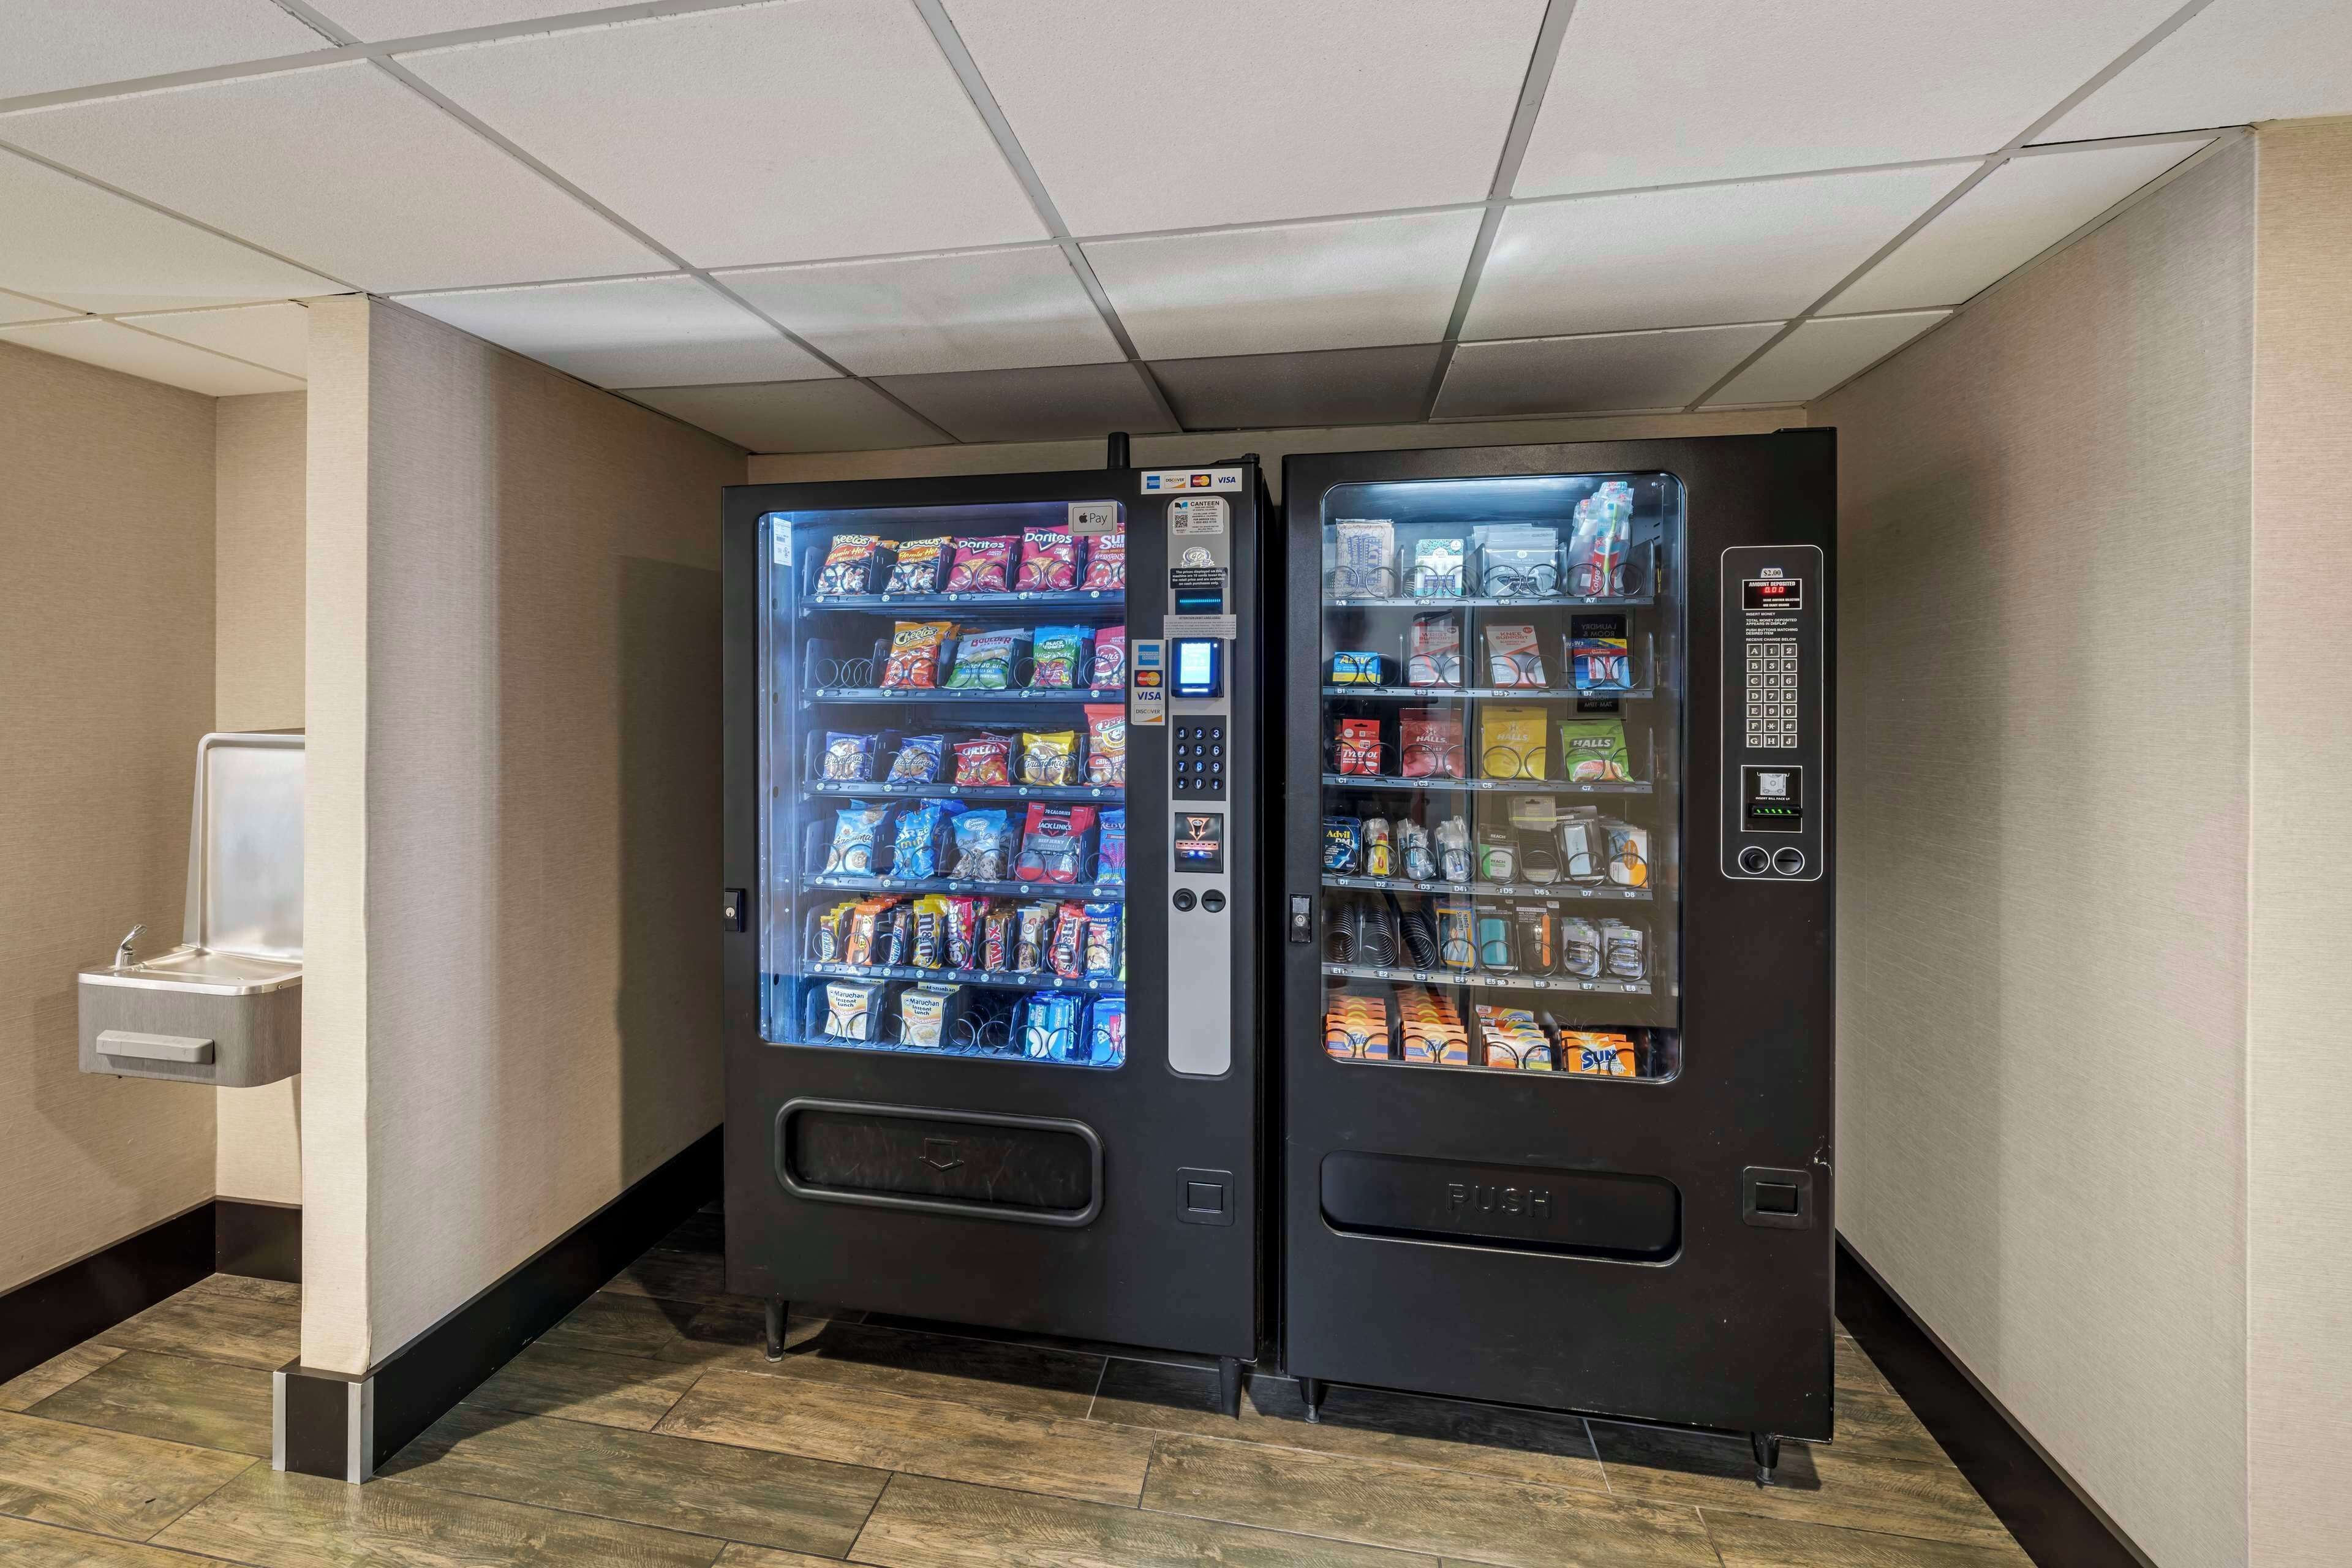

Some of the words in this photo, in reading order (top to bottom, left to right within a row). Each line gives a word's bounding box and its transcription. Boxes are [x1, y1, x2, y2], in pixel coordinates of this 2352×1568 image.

[1090, 513, 1107, 524] Pay
[1025, 533, 1071, 543] Doritos
[899, 551, 925, 561] Flamin'
[895, 627, 939, 646] Cheetos
[971, 638, 1011, 647] BOULDER
[1196, 746, 1202, 755] 5
[825, 755, 864, 764] Grandma's
[1025, 760, 1065, 769] Grandma's
[1196, 763, 1202, 771] 8
[1196, 780, 1201, 789] 0
[890, 925, 902, 963] SNICKERS
[988, 924, 1005, 969] TWIX
[1346, 1034, 1366, 1044] Tide
[1426, 1039, 1447, 1054] Tide
[1581, 1049, 1616, 1071] SUN
[1446, 1182, 1551, 1219] PUSH
